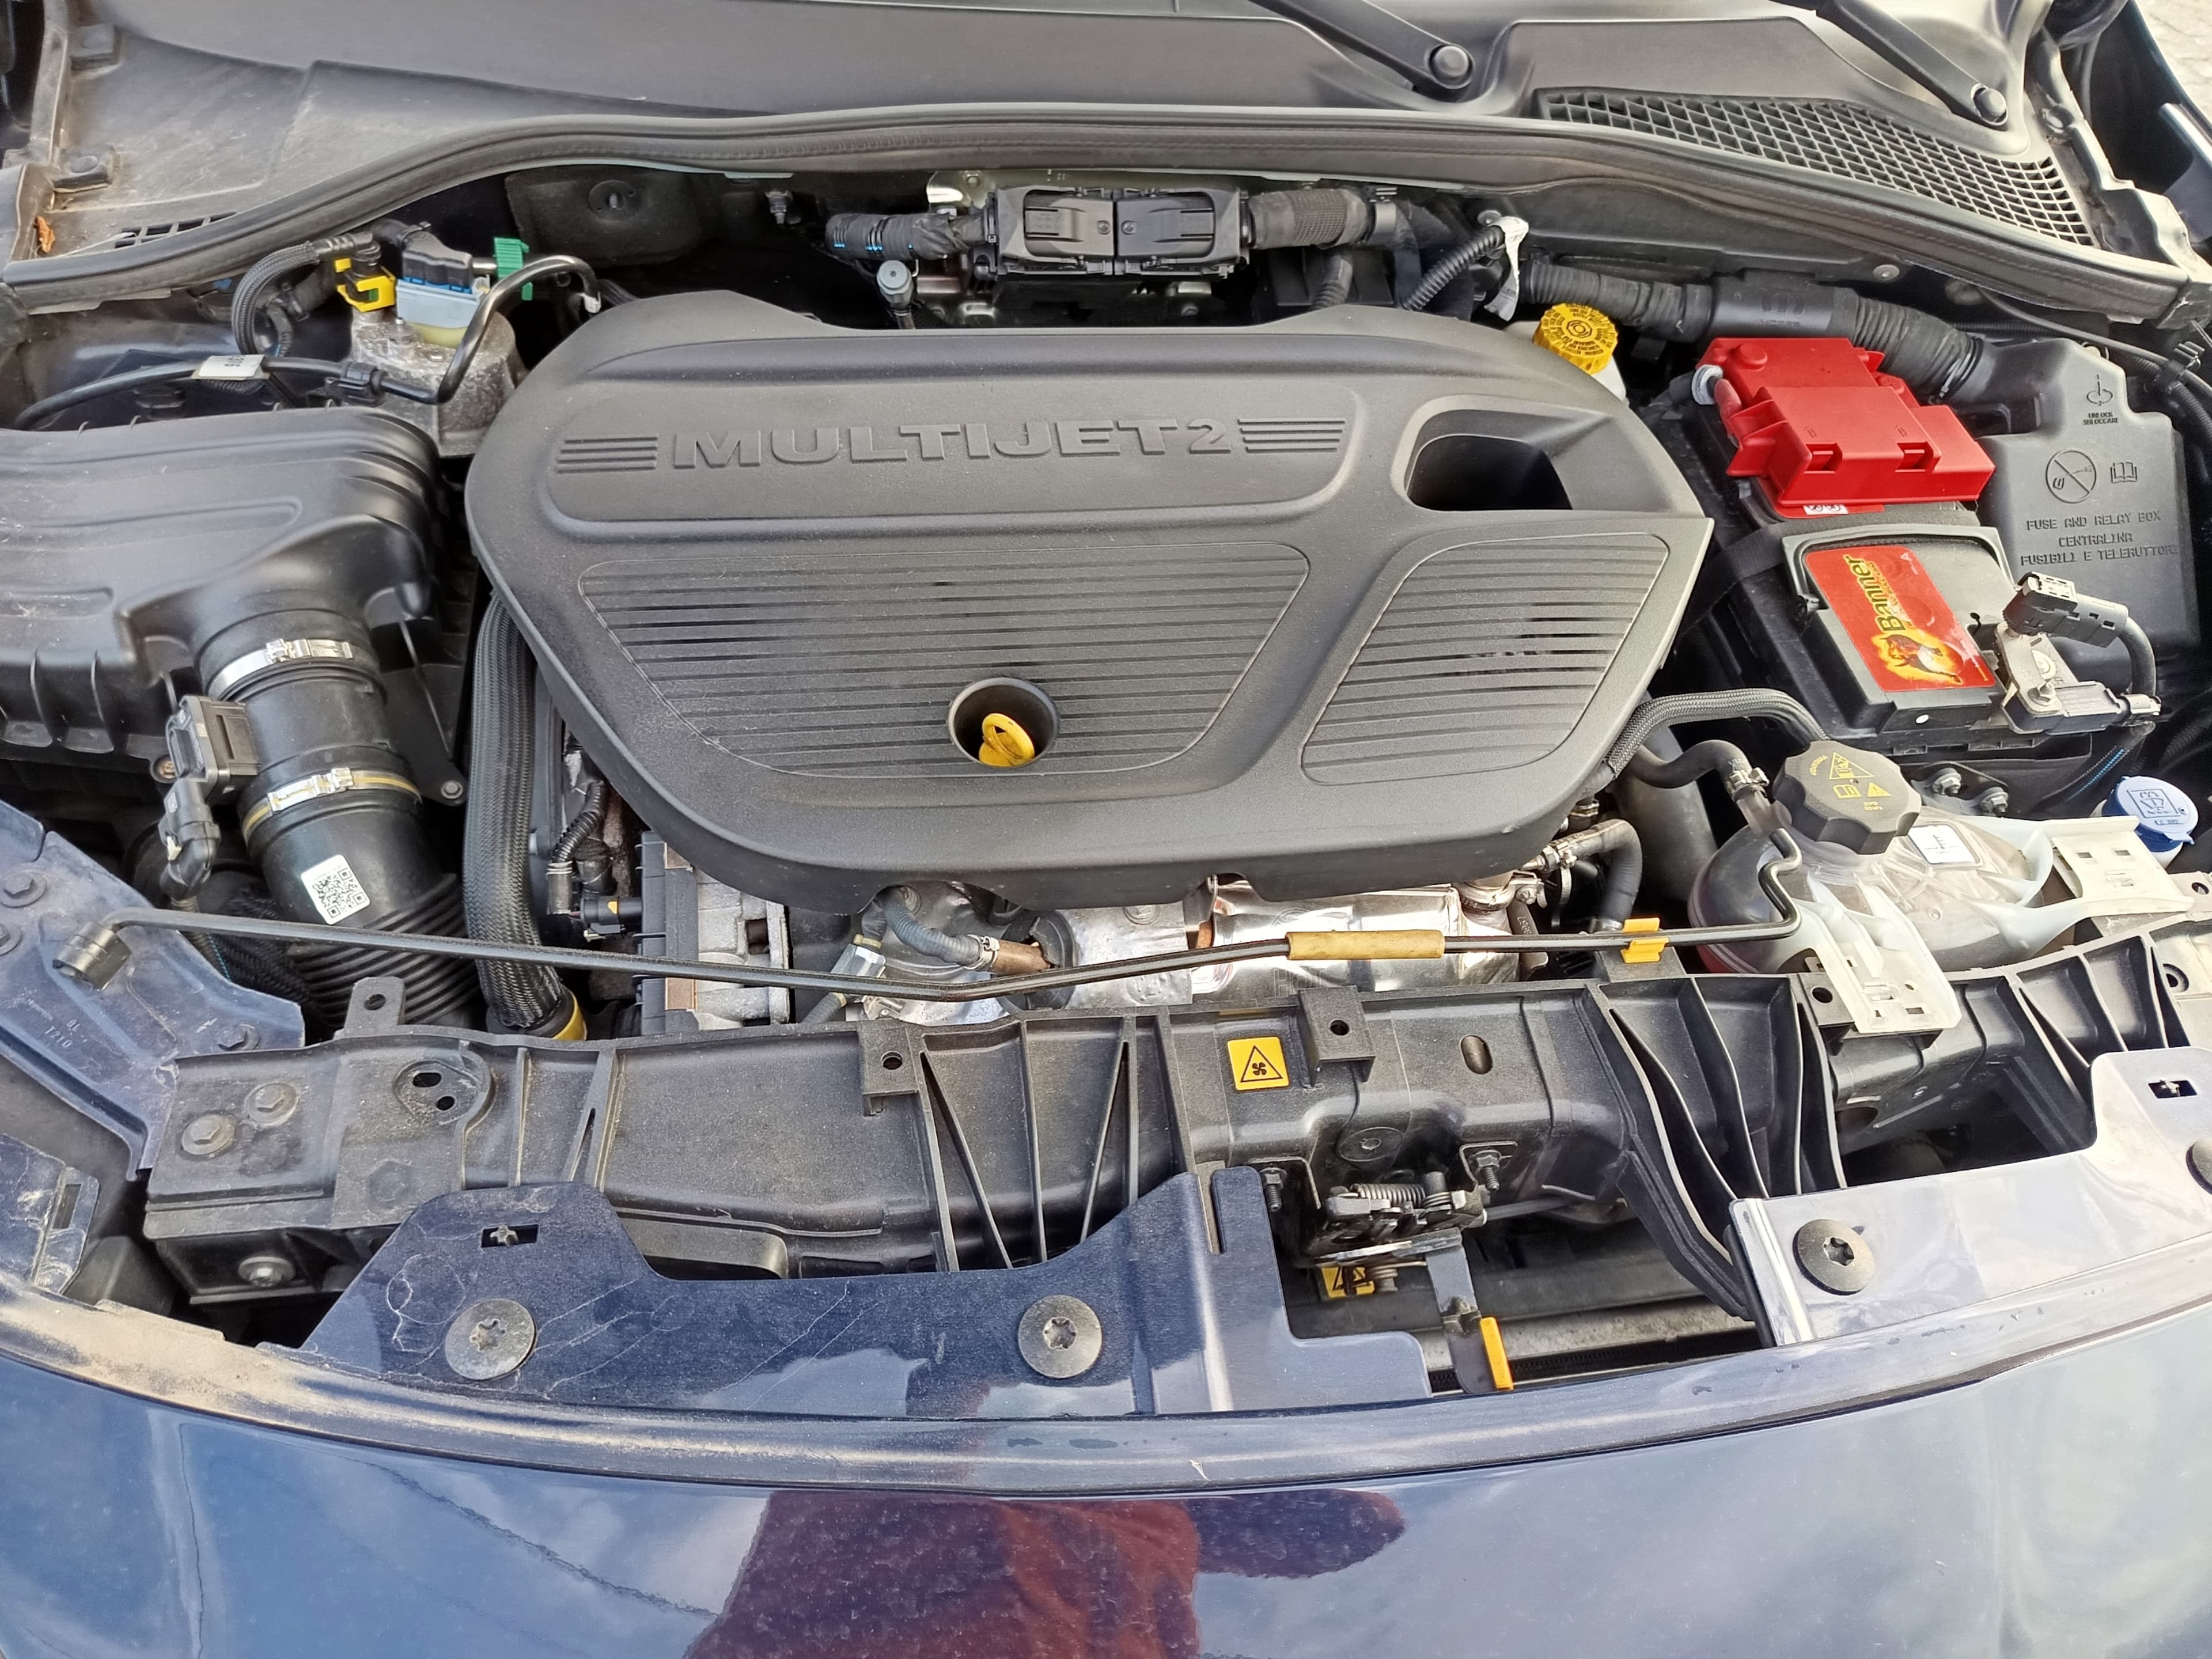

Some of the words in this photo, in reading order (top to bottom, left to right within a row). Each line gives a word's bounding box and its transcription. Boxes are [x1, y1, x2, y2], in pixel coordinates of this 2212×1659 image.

[2027, 518, 2057, 531] FUSE
[2064, 517, 2088, 528] AND
[2094, 513, 2131, 526] RELAY
[2138, 510, 2161, 522] BOX
[2058, 533, 2133, 547] CENTRALINA
[2020, 553, 2077, 566] FUSIBILI
[2084, 551, 2093, 562] E
[2097, 544, 2178, 560] TELERUTTORI
[1844, 555, 1907, 631] Banner
